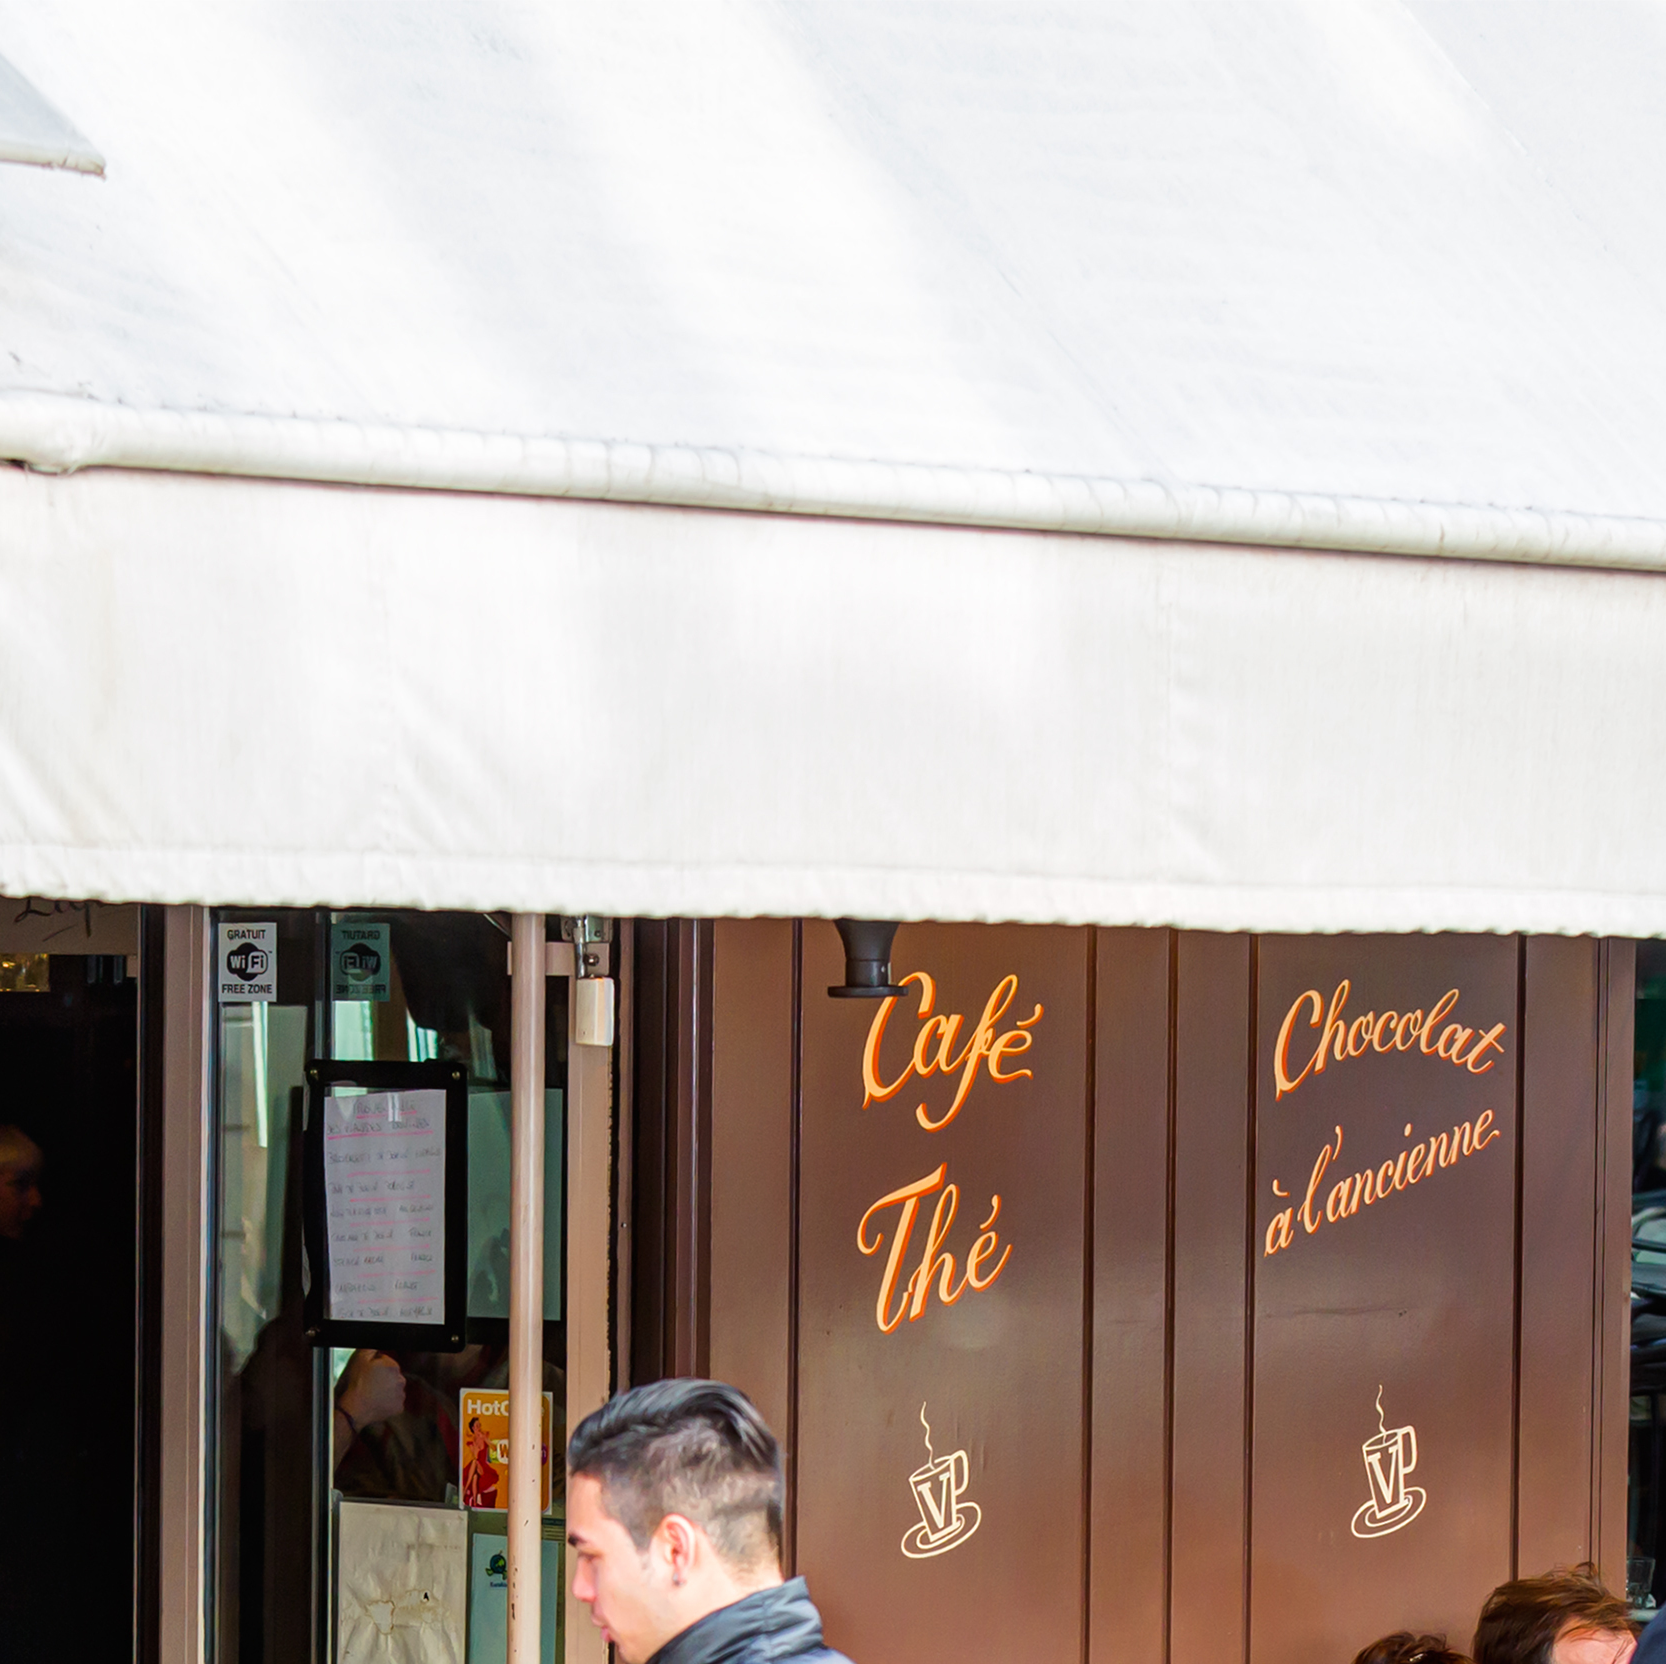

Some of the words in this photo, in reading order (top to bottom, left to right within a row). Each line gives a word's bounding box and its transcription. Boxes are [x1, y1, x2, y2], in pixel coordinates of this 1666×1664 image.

[222, 984, 245, 994] FREE
[248, 984, 273, 994] ZONE
[227, 929, 266, 940] GRATUIT
[862, 971, 1044, 1132] Café
[1274, 979, 1507, 1101] Chocolat
[856, 1162, 1013, 1334] Thé
[1264, 1179, 1290, 1257] à
[1296, 1108, 1501, 1234] l'ancienne
